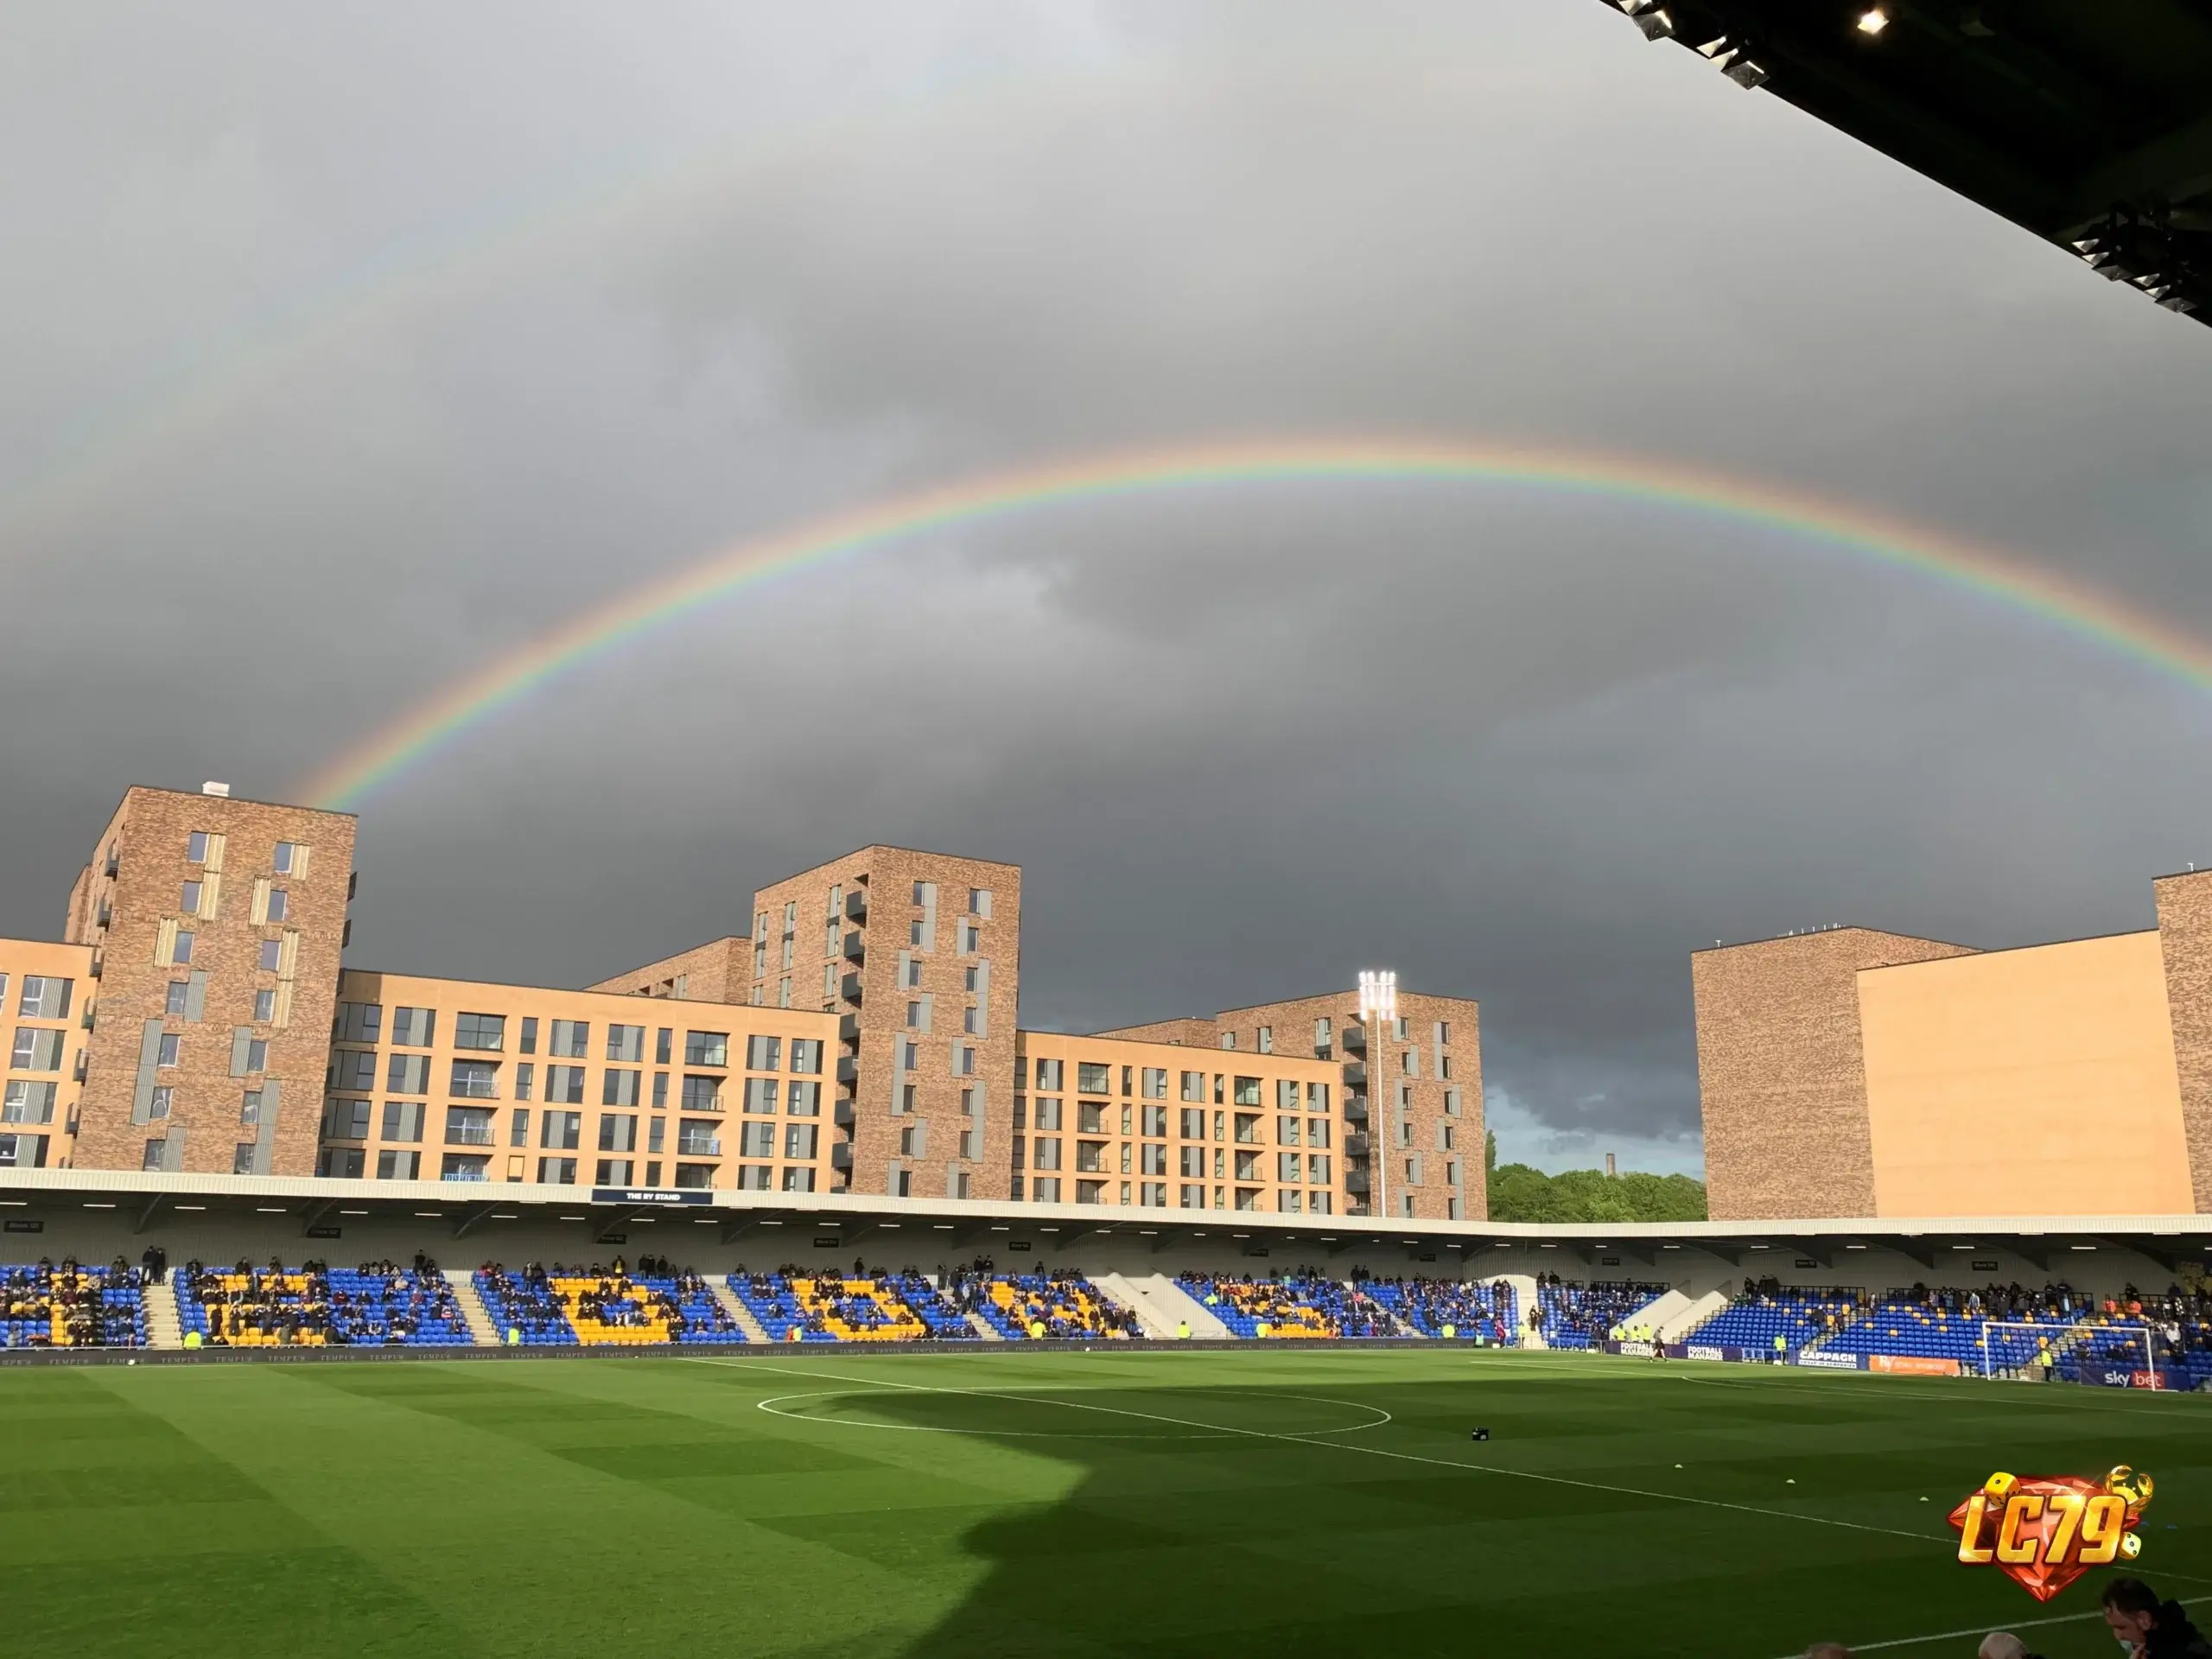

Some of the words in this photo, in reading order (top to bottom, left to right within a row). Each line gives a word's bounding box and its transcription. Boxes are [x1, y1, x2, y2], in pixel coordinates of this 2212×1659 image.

[1688, 1346, 1723, 1355] FOOTBALL
[1688, 1352, 1723, 1361] MANAGER
[1799, 1351, 1857, 1362] CAPPAGH
[2105, 1370, 2130, 1387] sky
[2134, 1372, 2161, 1386] bet
